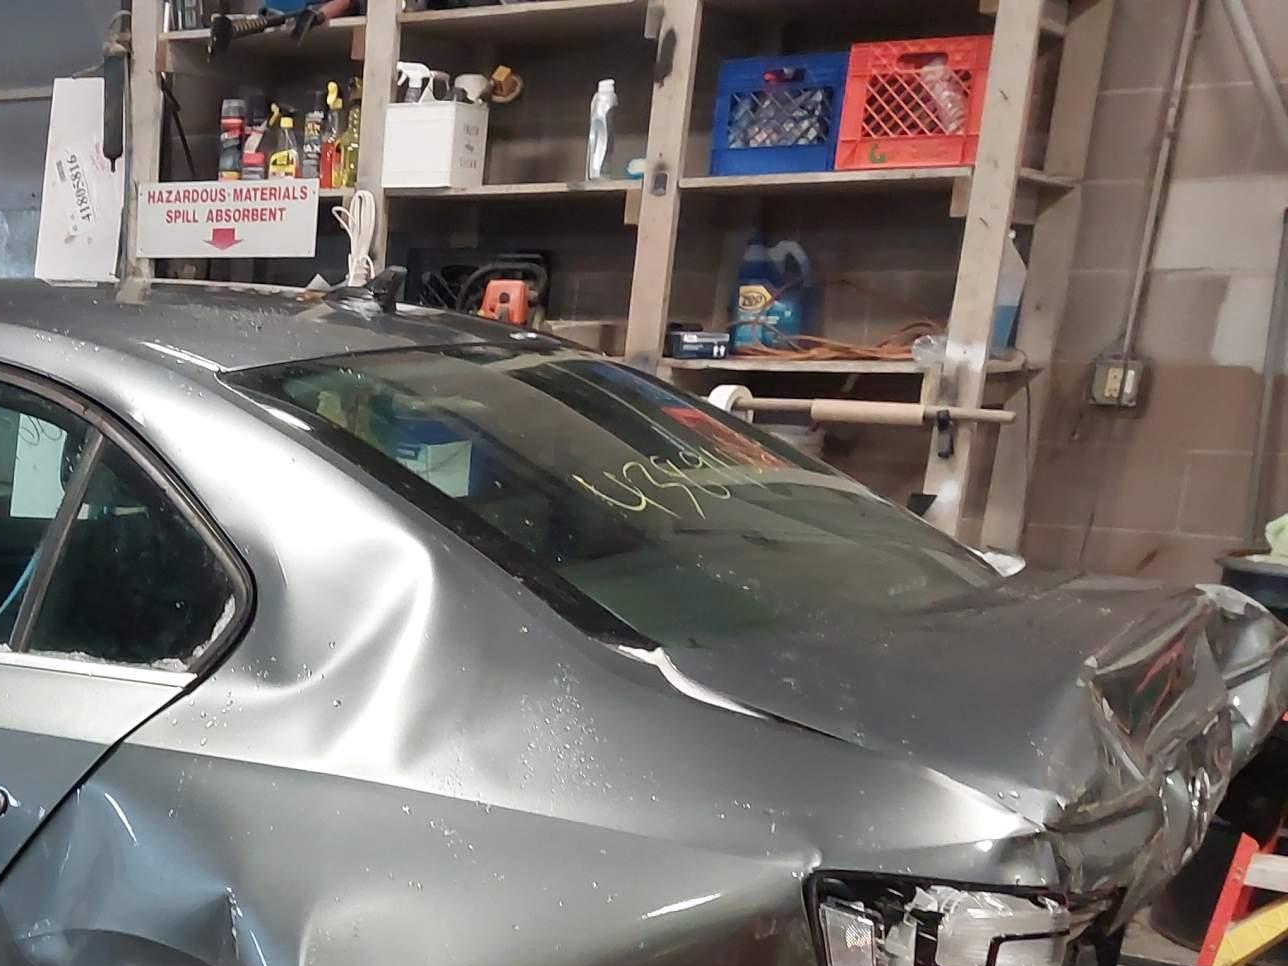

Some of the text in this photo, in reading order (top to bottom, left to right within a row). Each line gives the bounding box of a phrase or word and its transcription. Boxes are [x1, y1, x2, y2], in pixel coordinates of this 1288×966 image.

[66, 154, 92, 222] 41805816
[147, 185, 309, 204] HAZARDOUS MATERIALS
[165, 207, 286, 223] SPILL ABSORBENT
